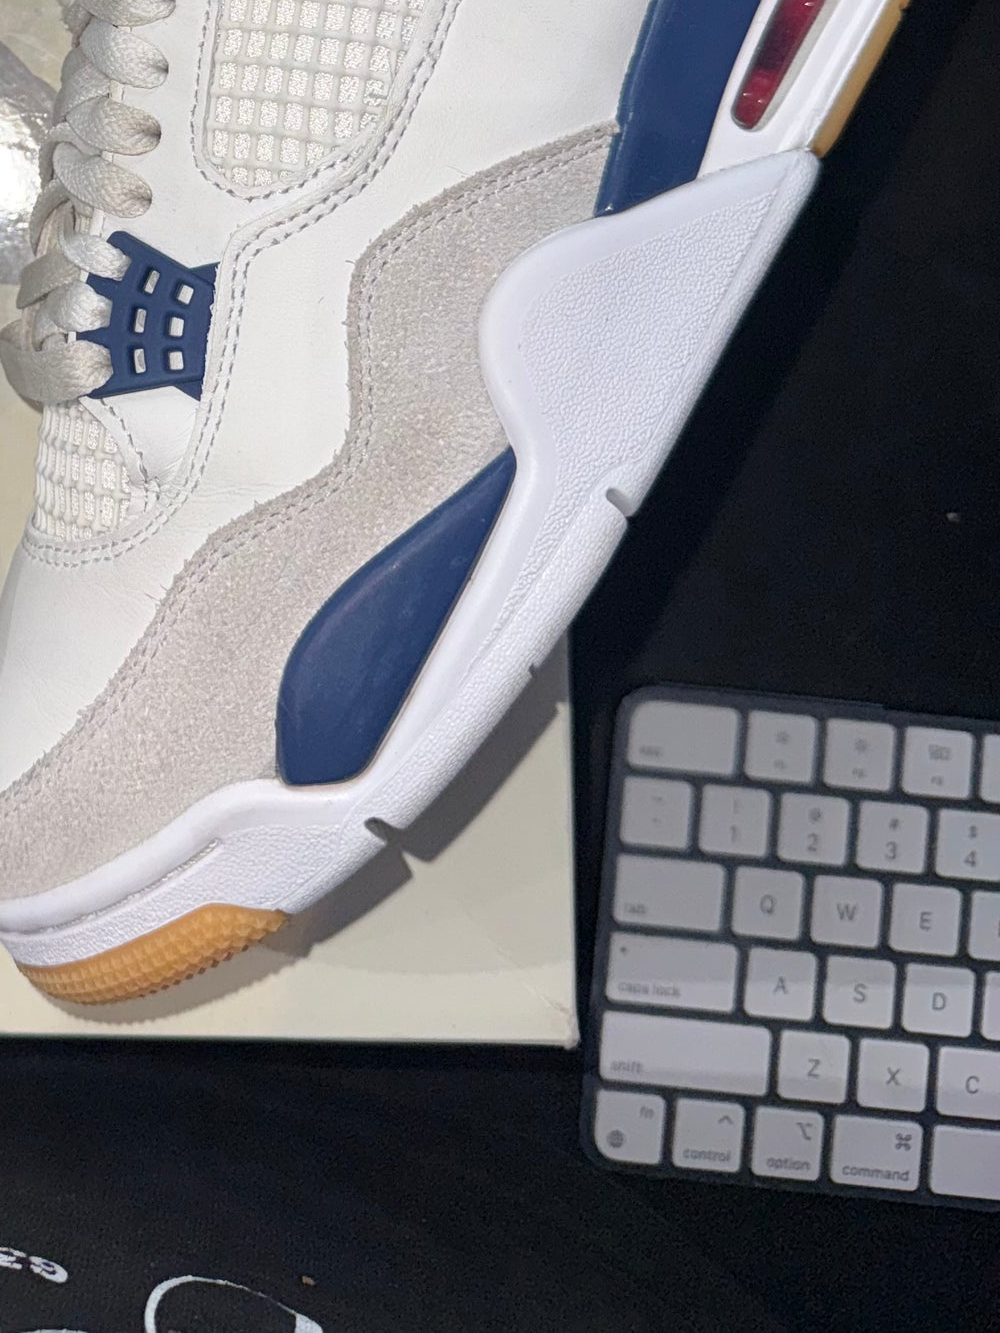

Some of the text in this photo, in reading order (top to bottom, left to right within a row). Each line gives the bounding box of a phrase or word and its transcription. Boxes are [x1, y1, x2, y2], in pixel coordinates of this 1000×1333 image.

[806, 833, 818, 852] 2
[885, 842, 897, 860] 3
[964, 850, 976, 867] 4
[760, 894, 776, 915] Q
[837, 903, 858, 922] W
[920, 912, 932, 931] E
[774, 976, 788, 994] A
[853, 983, 868, 1003] S
[932, 992, 947, 1011] D
[808, 1059, 821, 1078] Z
[886, 1067, 900, 1086] X
[966, 1075, 980, 1094] C
[683, 1148, 731, 1162] control
[766, 1156, 810, 1172] option
[842, 1165, 909, 1182] command
